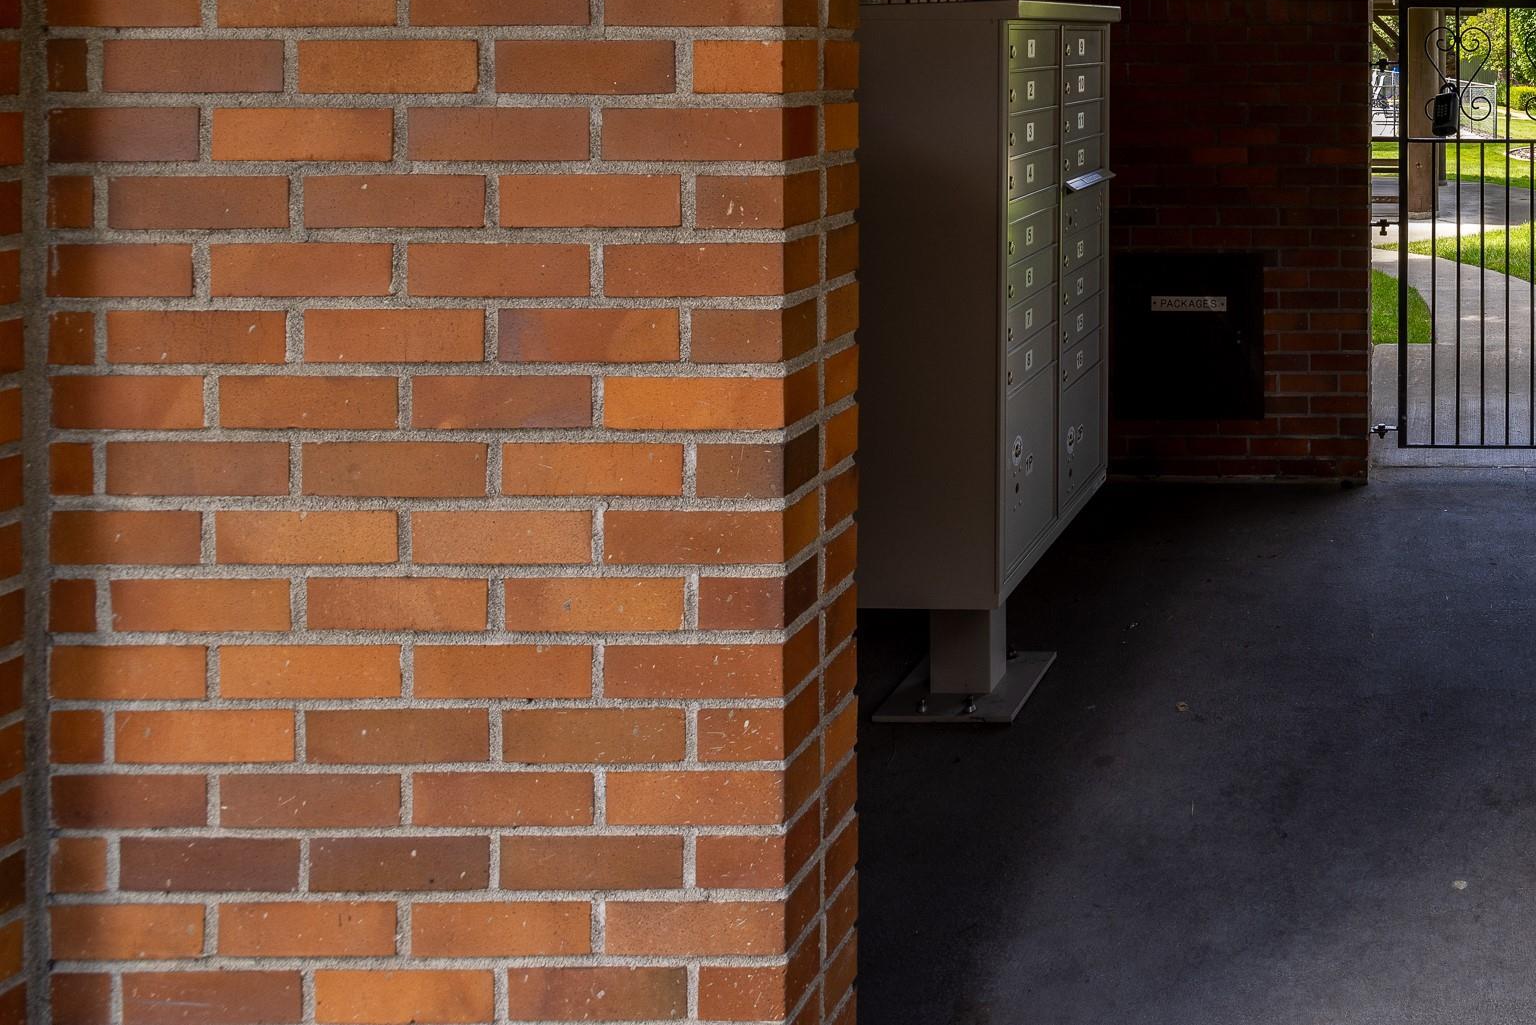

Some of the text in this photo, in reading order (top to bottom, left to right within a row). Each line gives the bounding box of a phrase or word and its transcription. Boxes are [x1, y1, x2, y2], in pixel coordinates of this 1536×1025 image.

[1028, 82, 1034, 97] 2
[1028, 124, 1034, 139] 3
[1160, 299, 1217, 309] PACKAGES
